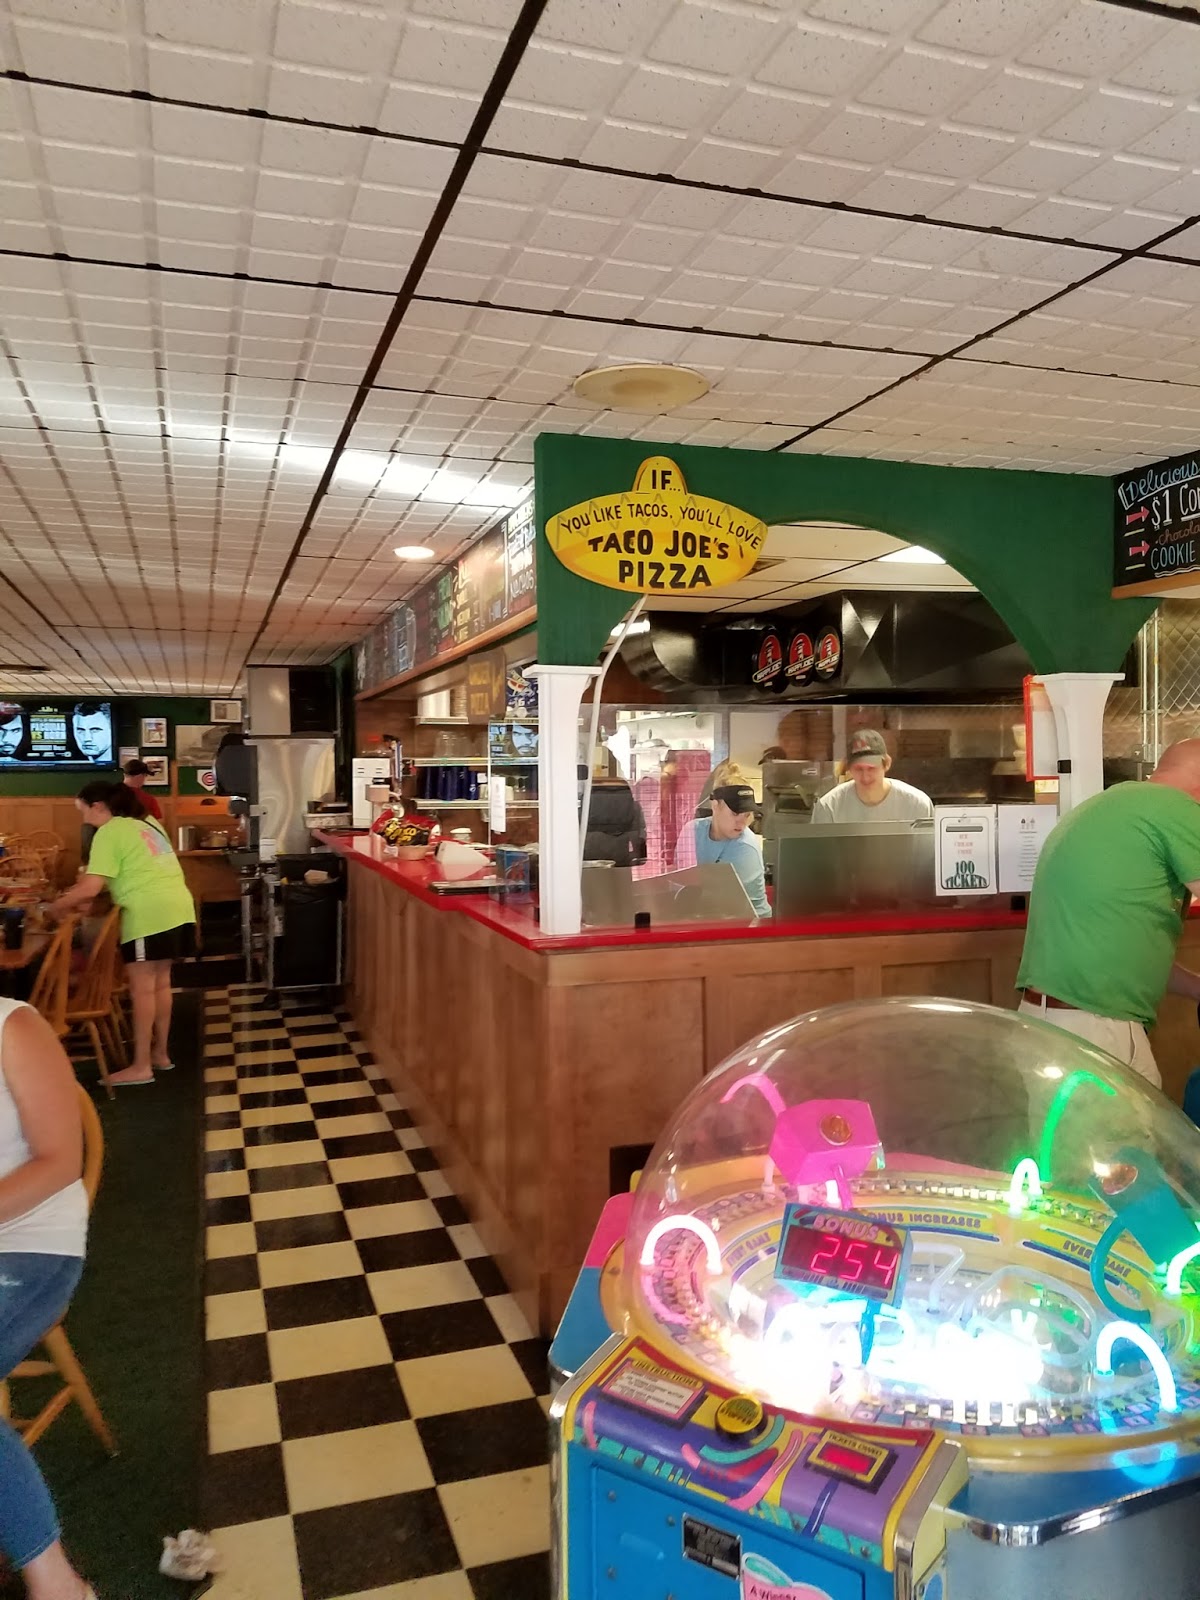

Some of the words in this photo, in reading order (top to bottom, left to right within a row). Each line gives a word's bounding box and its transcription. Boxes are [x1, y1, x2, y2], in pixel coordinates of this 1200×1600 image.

[1151, 489, 1173, 530] $1
[560, 512, 591, 534] YOU
[594, 504, 623, 523] LIKE
[679, 505, 722, 529] YOU'LL
[728, 521, 762, 550] LOVE
[588, 529, 654, 555] TACO
[664, 530, 729, 560] JOE'S
[1151, 540, 1196, 571] COOKIE
[619, 560, 712, 589] PIZZA
[945, 874, 987, 888] TICKETS
[955, 860, 975, 875] 100
[813, 1214, 879, 1240] BONUS
[909, 1213, 981, 1228] INCREASES
[810, 1236, 898, 1286] 254
[1063, 1240, 1093, 1259] EVER
[1106, 1256, 1131, 1277] AME
